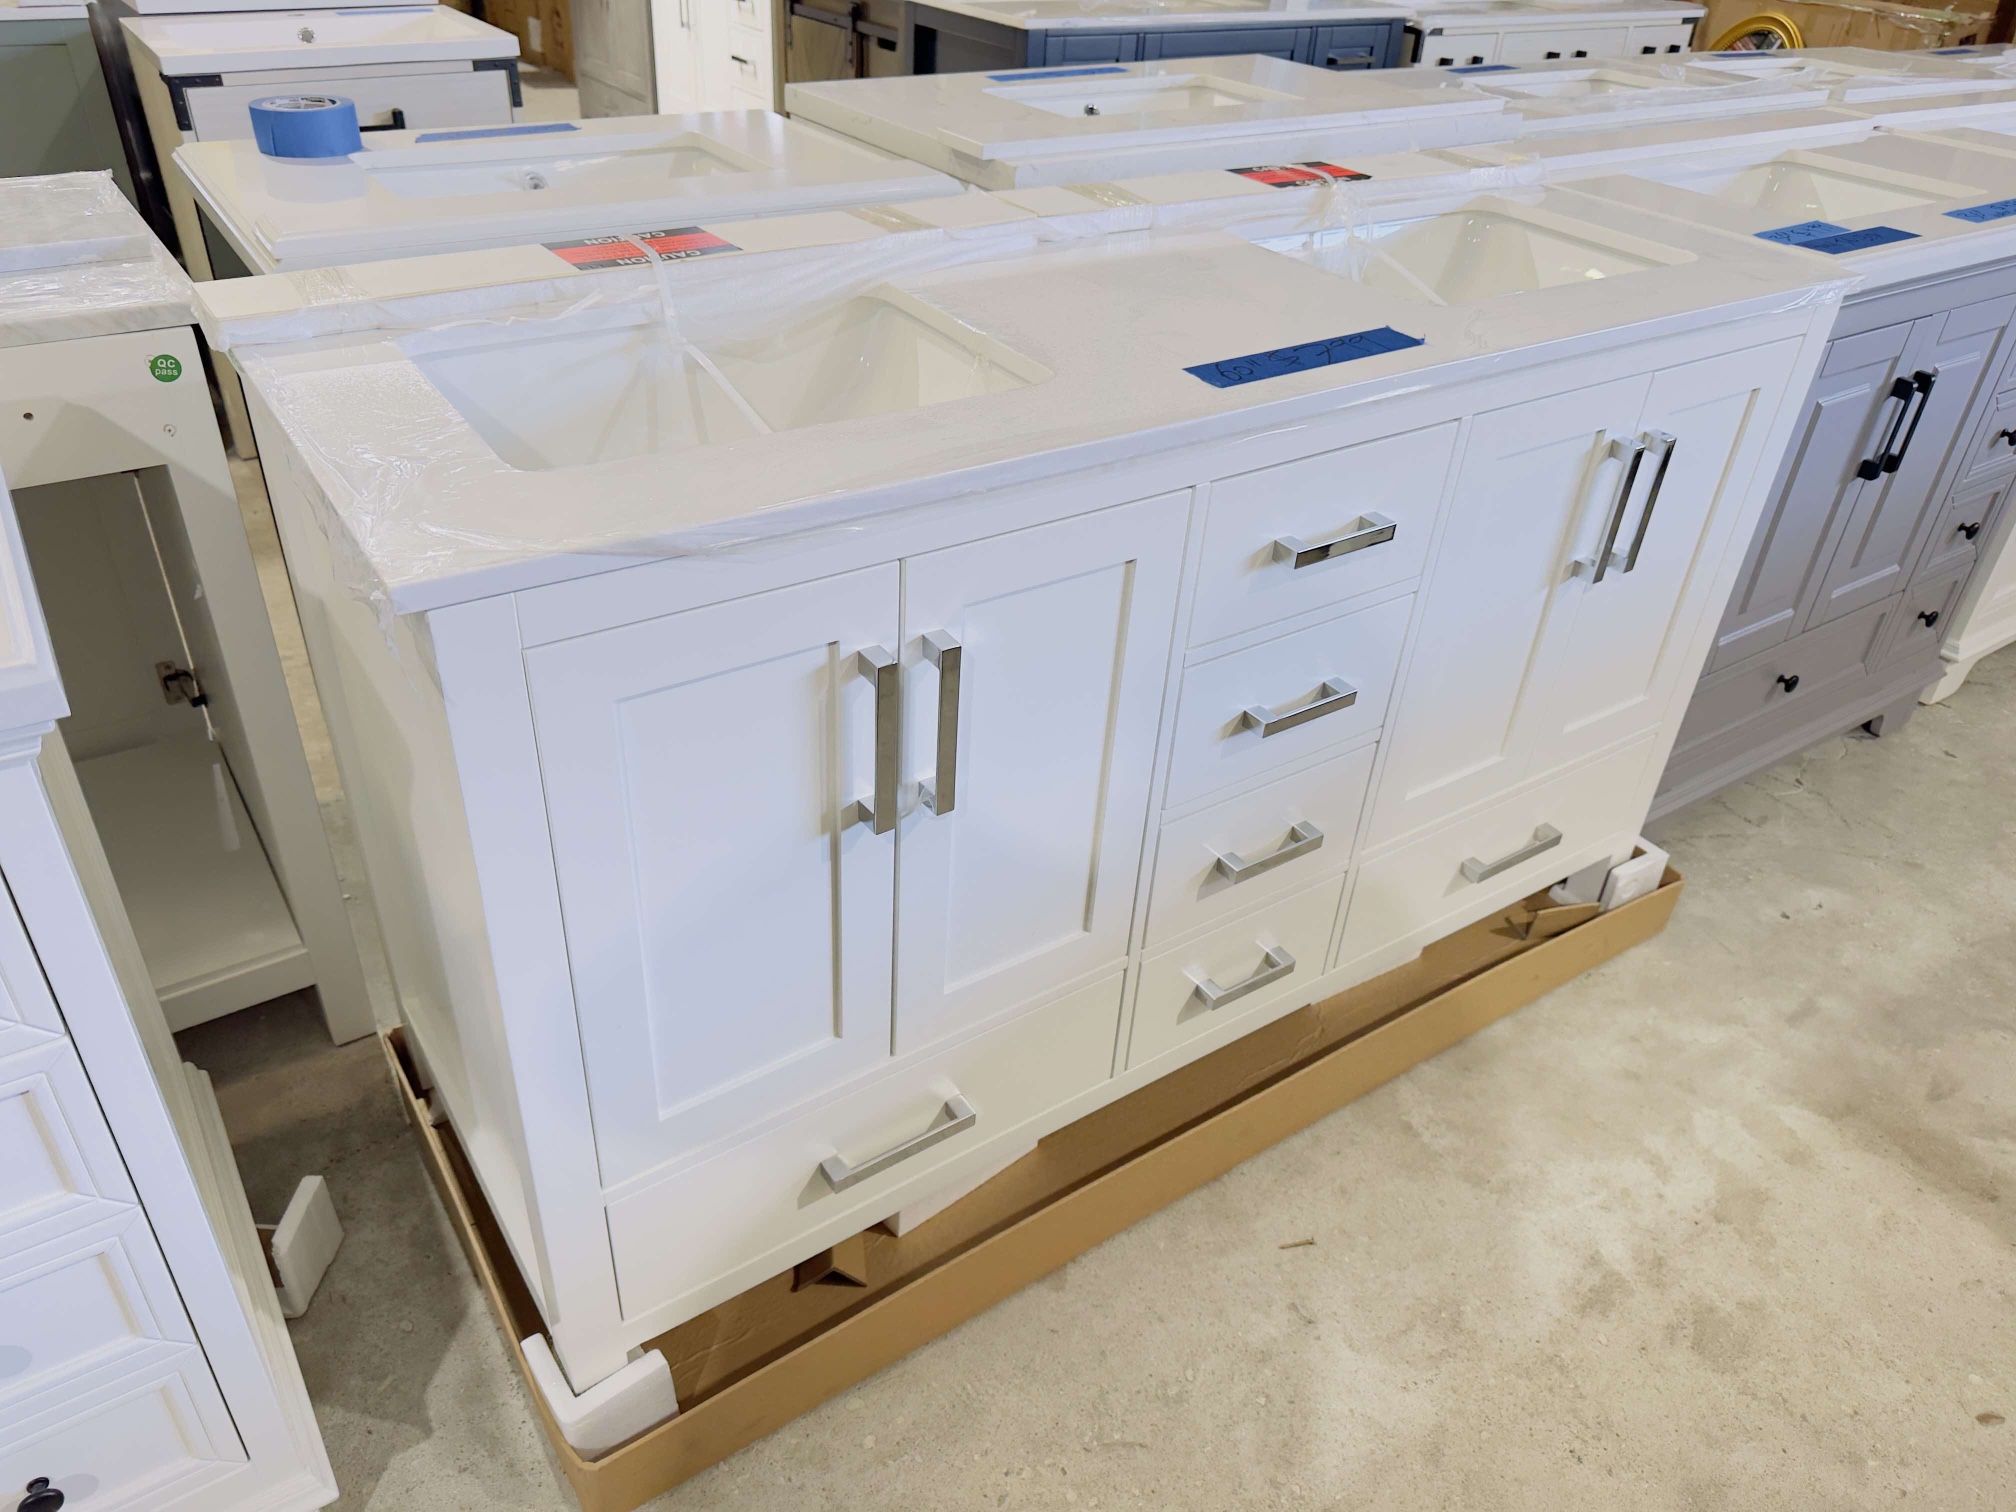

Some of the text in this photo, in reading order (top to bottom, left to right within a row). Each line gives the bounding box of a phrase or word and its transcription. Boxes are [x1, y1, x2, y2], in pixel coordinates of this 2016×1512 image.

[583, 231, 666, 245] CAION
[616, 250, 701, 266] CAUION
[157, 358, 176, 368] QC
[155, 368, 178, 377] pass
